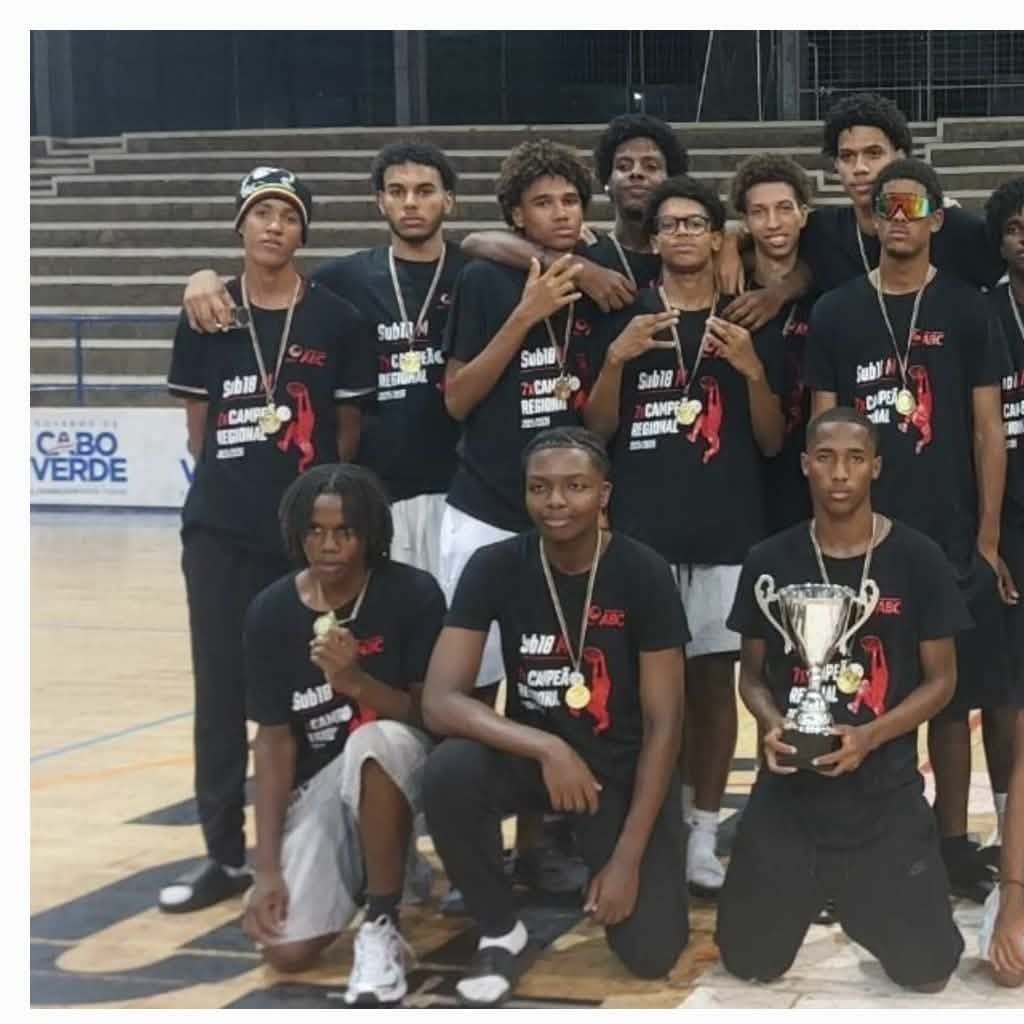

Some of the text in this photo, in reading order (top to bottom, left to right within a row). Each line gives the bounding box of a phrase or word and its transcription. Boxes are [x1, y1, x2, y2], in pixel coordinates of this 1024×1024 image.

[520, 346, 556, 369] Sub18
[637, 369, 674, 391] Sub18
[36, 431, 118, 456] CABO
[30, 457, 128, 482] VERDE
[600, 609, 625, 628] ABC
